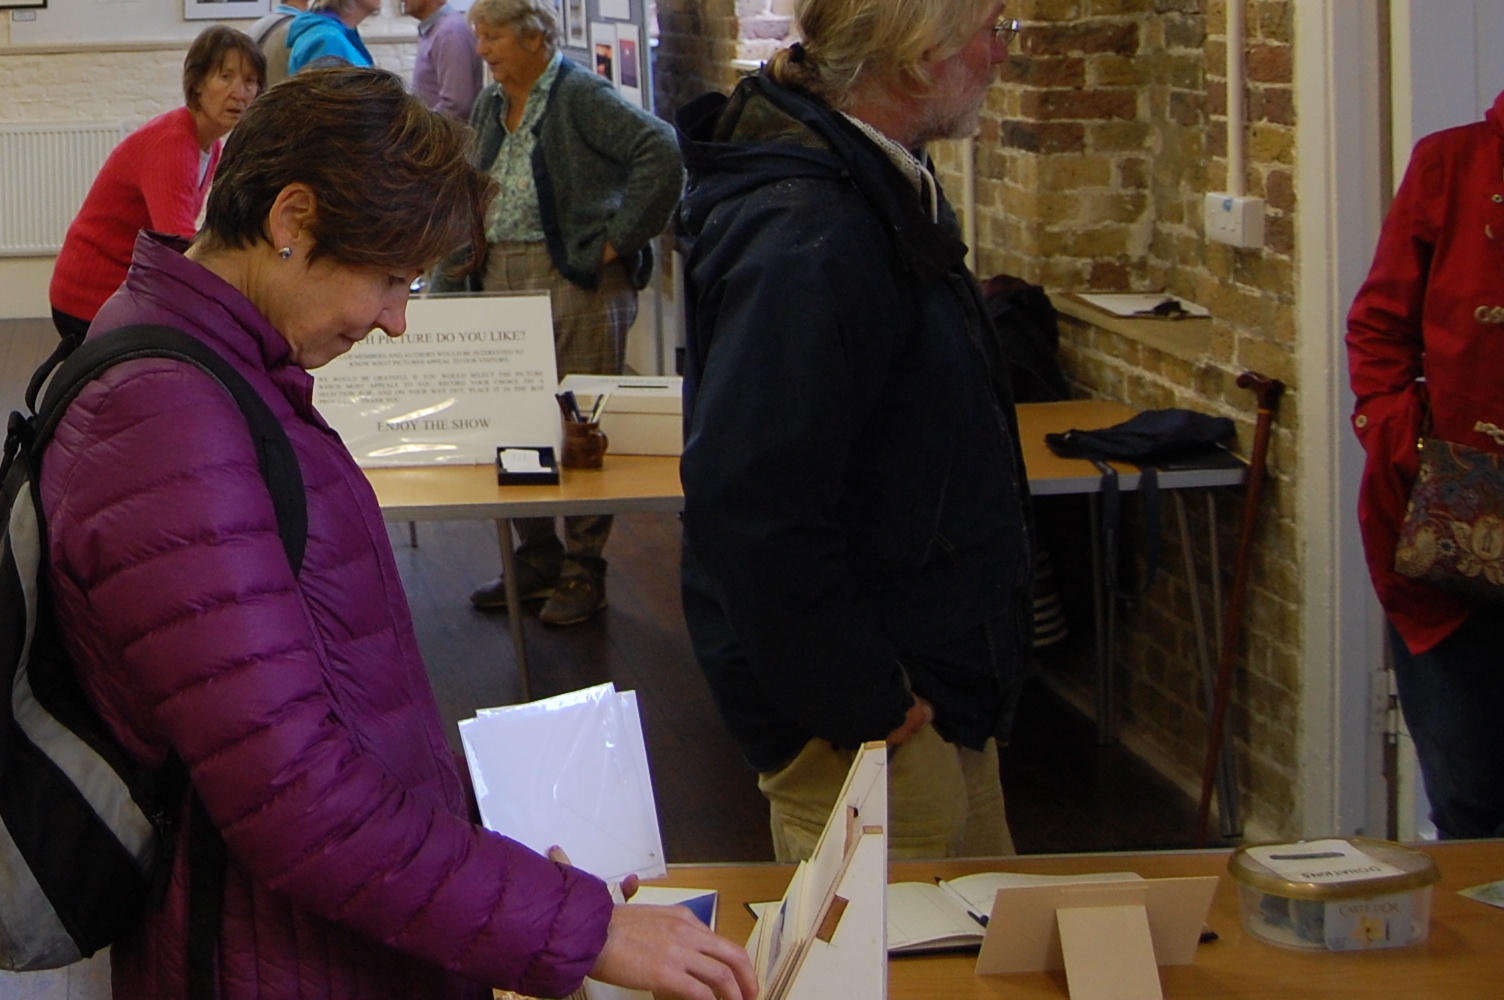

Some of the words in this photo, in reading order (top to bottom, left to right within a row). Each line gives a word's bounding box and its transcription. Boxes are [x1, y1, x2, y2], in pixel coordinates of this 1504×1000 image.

[378, 333, 433, 345] PICTURE
[436, 332, 456, 343] DO
[458, 331, 487, 342] YOU
[490, 330, 526, 342] LIKE?
[377, 420, 418, 431] ENJOY
[423, 419, 448, 430] THE
[452, 418, 491, 429] SHOW
[1301, 865, 1382, 879] DONATIONS
